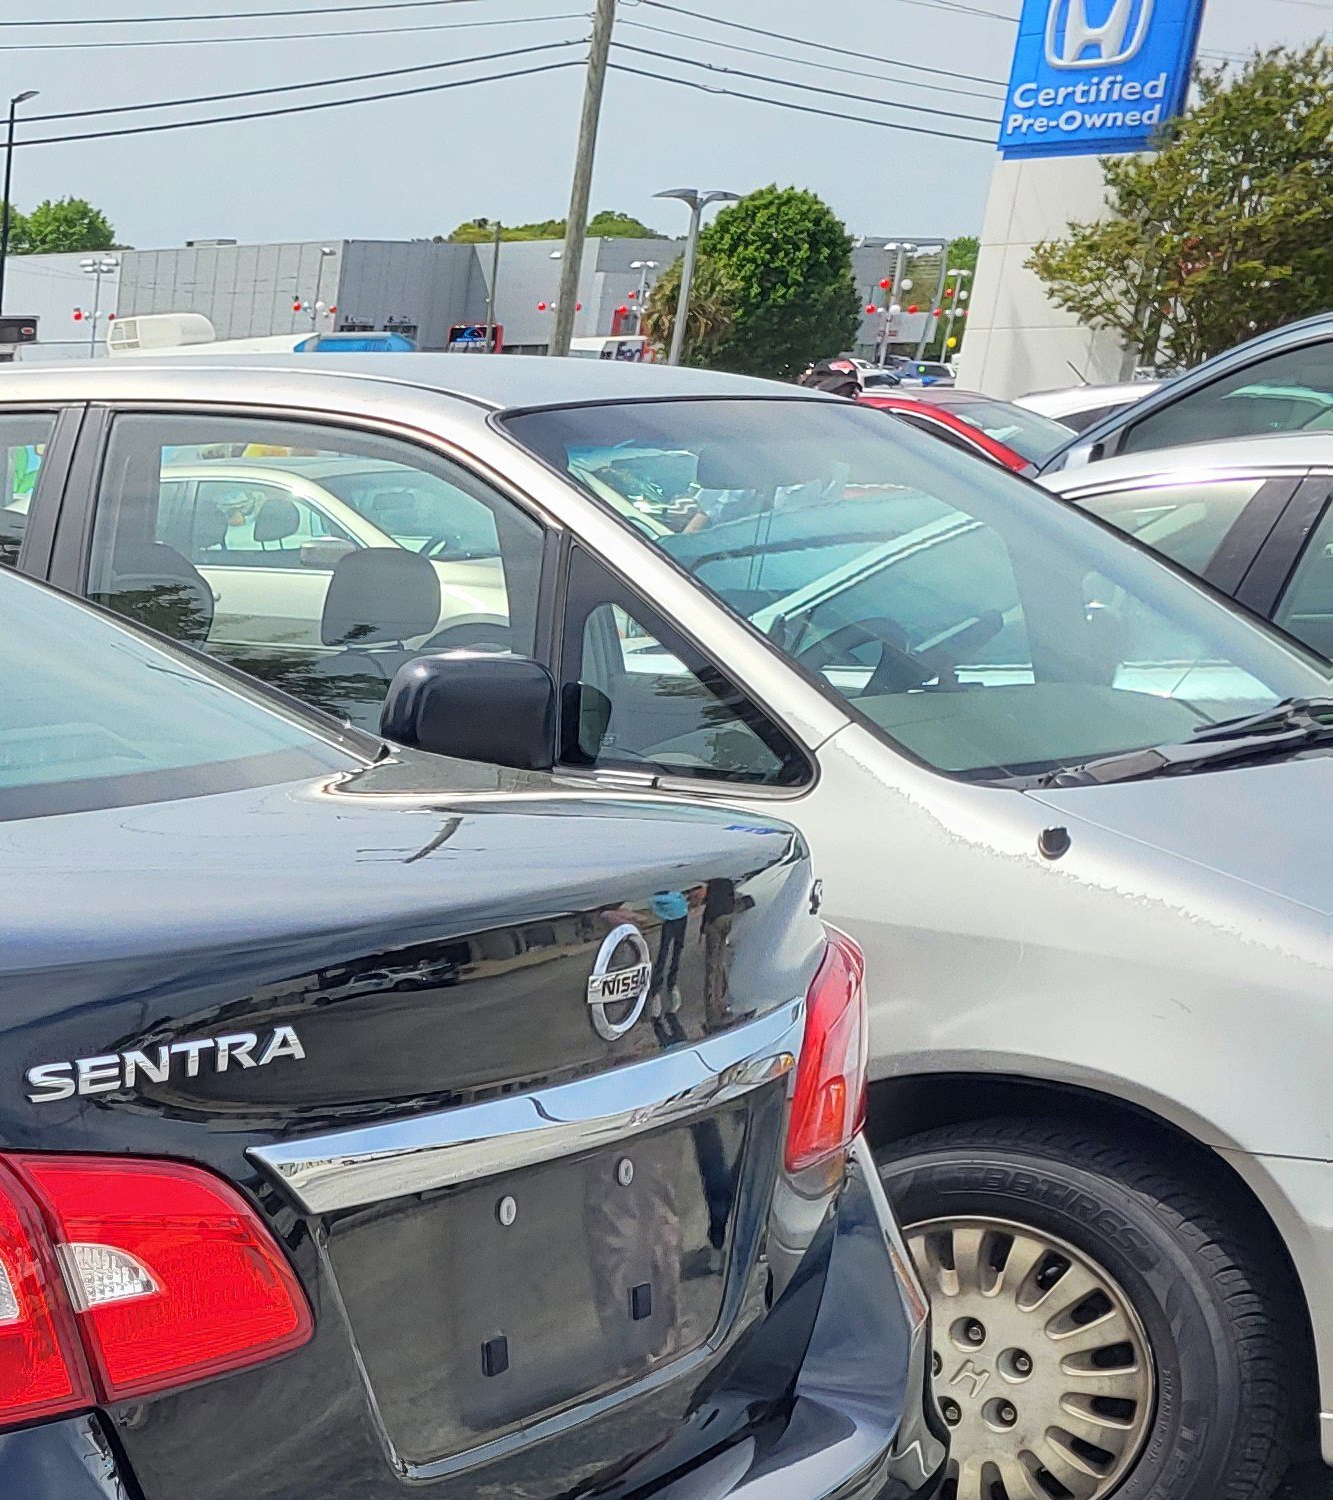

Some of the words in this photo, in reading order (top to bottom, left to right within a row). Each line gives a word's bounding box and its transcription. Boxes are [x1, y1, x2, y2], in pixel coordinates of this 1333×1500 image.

[1013, 72, 1168, 109] Certified
[1006, 104, 1162, 135] Pre-Owned
[25, 1025, 306, 1104] SENTRA
